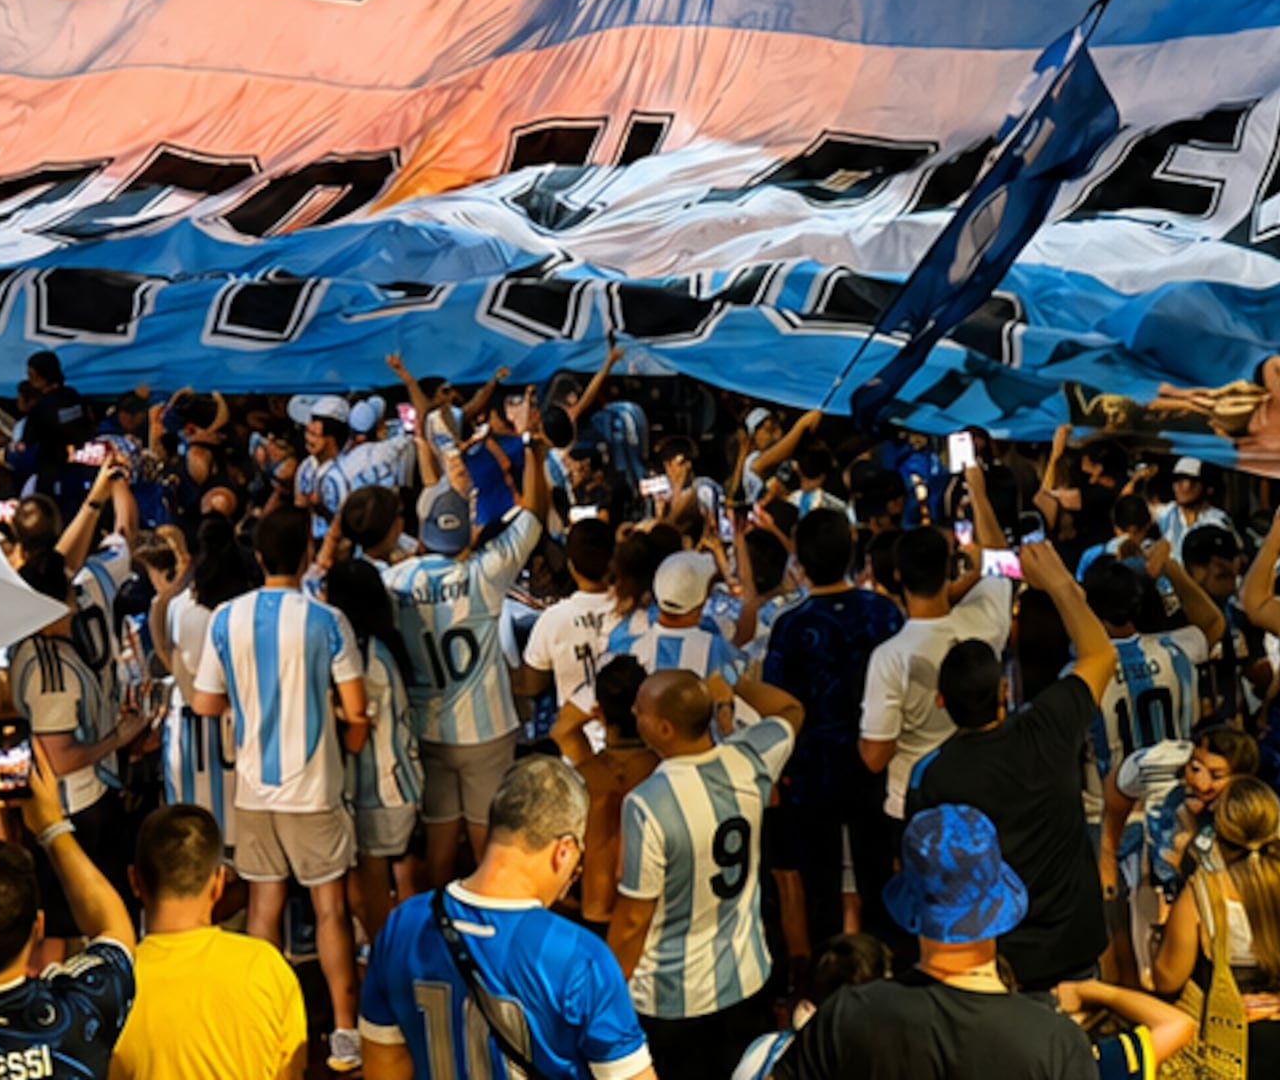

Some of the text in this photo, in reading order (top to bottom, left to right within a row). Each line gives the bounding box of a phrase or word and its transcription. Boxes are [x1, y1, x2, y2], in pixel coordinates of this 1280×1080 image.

[423, 627, 480, 690] 10
[1114, 686, 1178, 762] 10
[710, 814, 752, 900] 9
